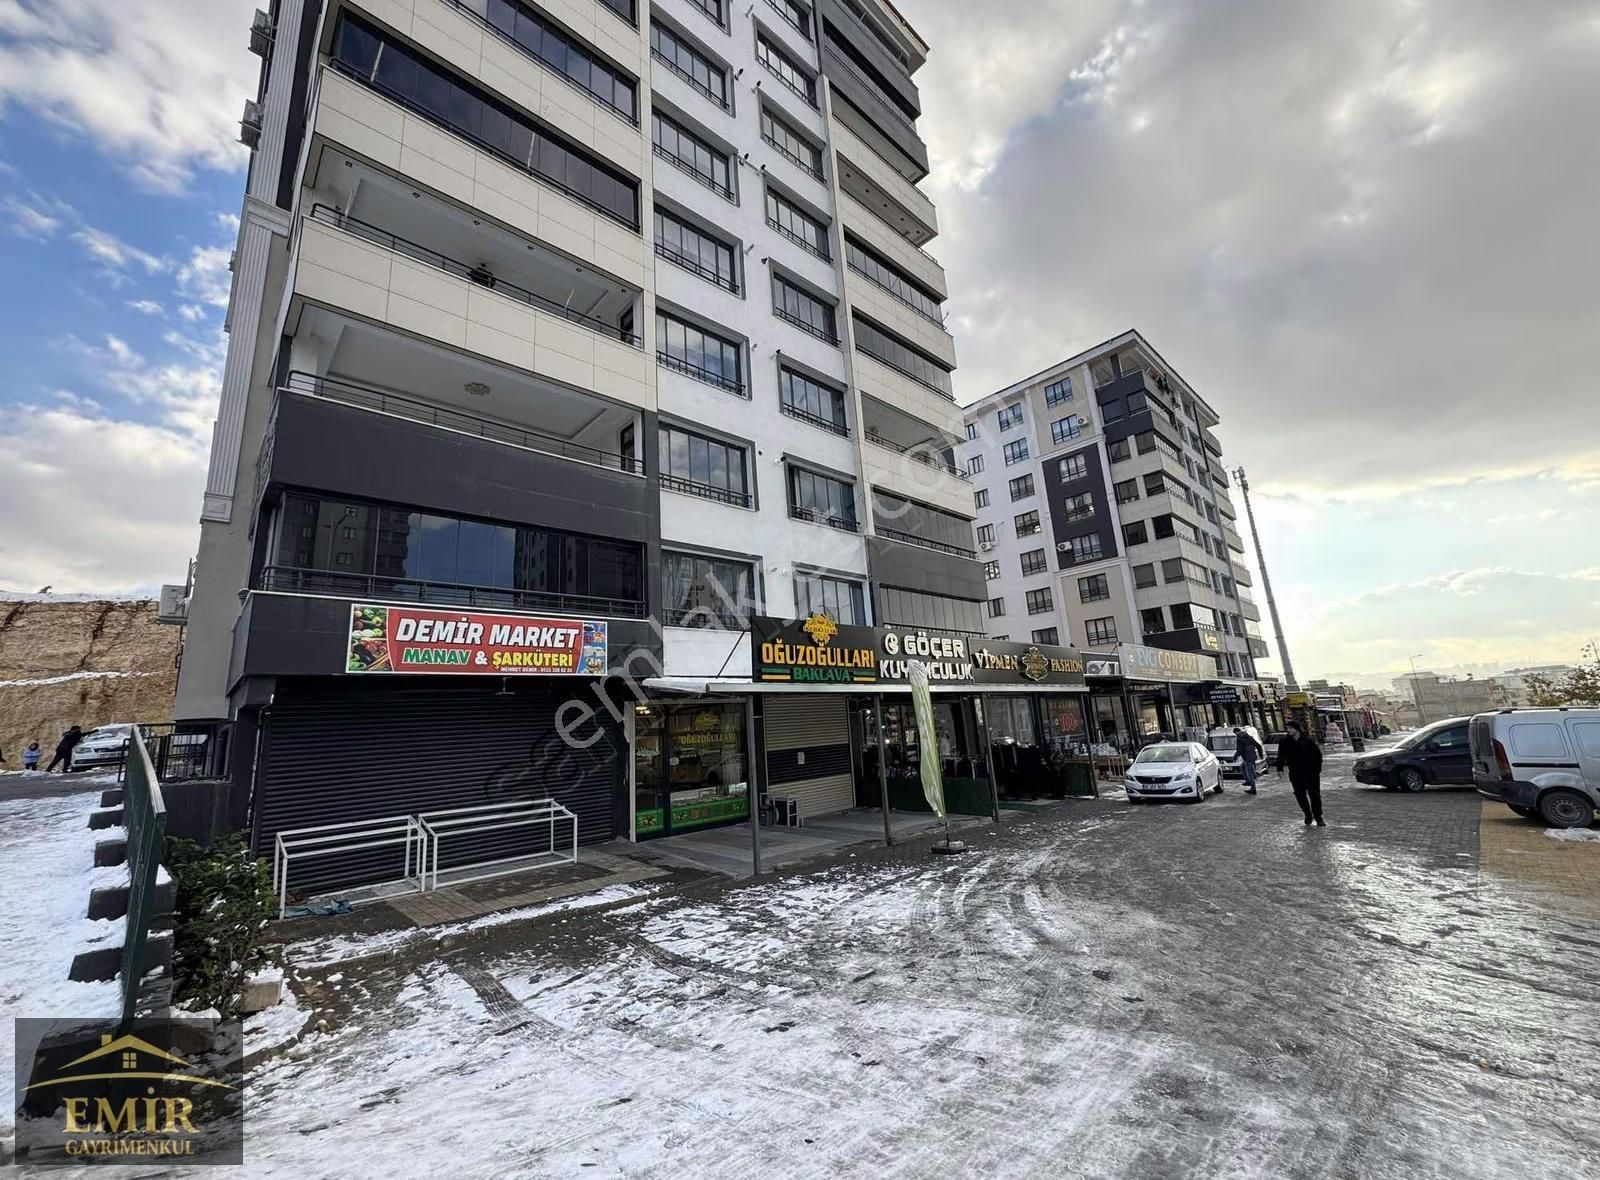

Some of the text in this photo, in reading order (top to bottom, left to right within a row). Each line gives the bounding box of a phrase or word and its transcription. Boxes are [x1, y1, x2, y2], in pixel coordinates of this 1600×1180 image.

[395, 617, 580, 649] DEMİR MARKET
[761, 637, 875, 668] OĞUZOĞULLARI
[904, 631, 965, 659] GÖÇER
[402, 647, 573, 670] MANAV & ŞARKÜTERİ
[880, 659, 974, 680] KUYMCULUK
[1050, 658, 1083, 673] FASHION
[793, 667, 850, 681] BAKLAVA
